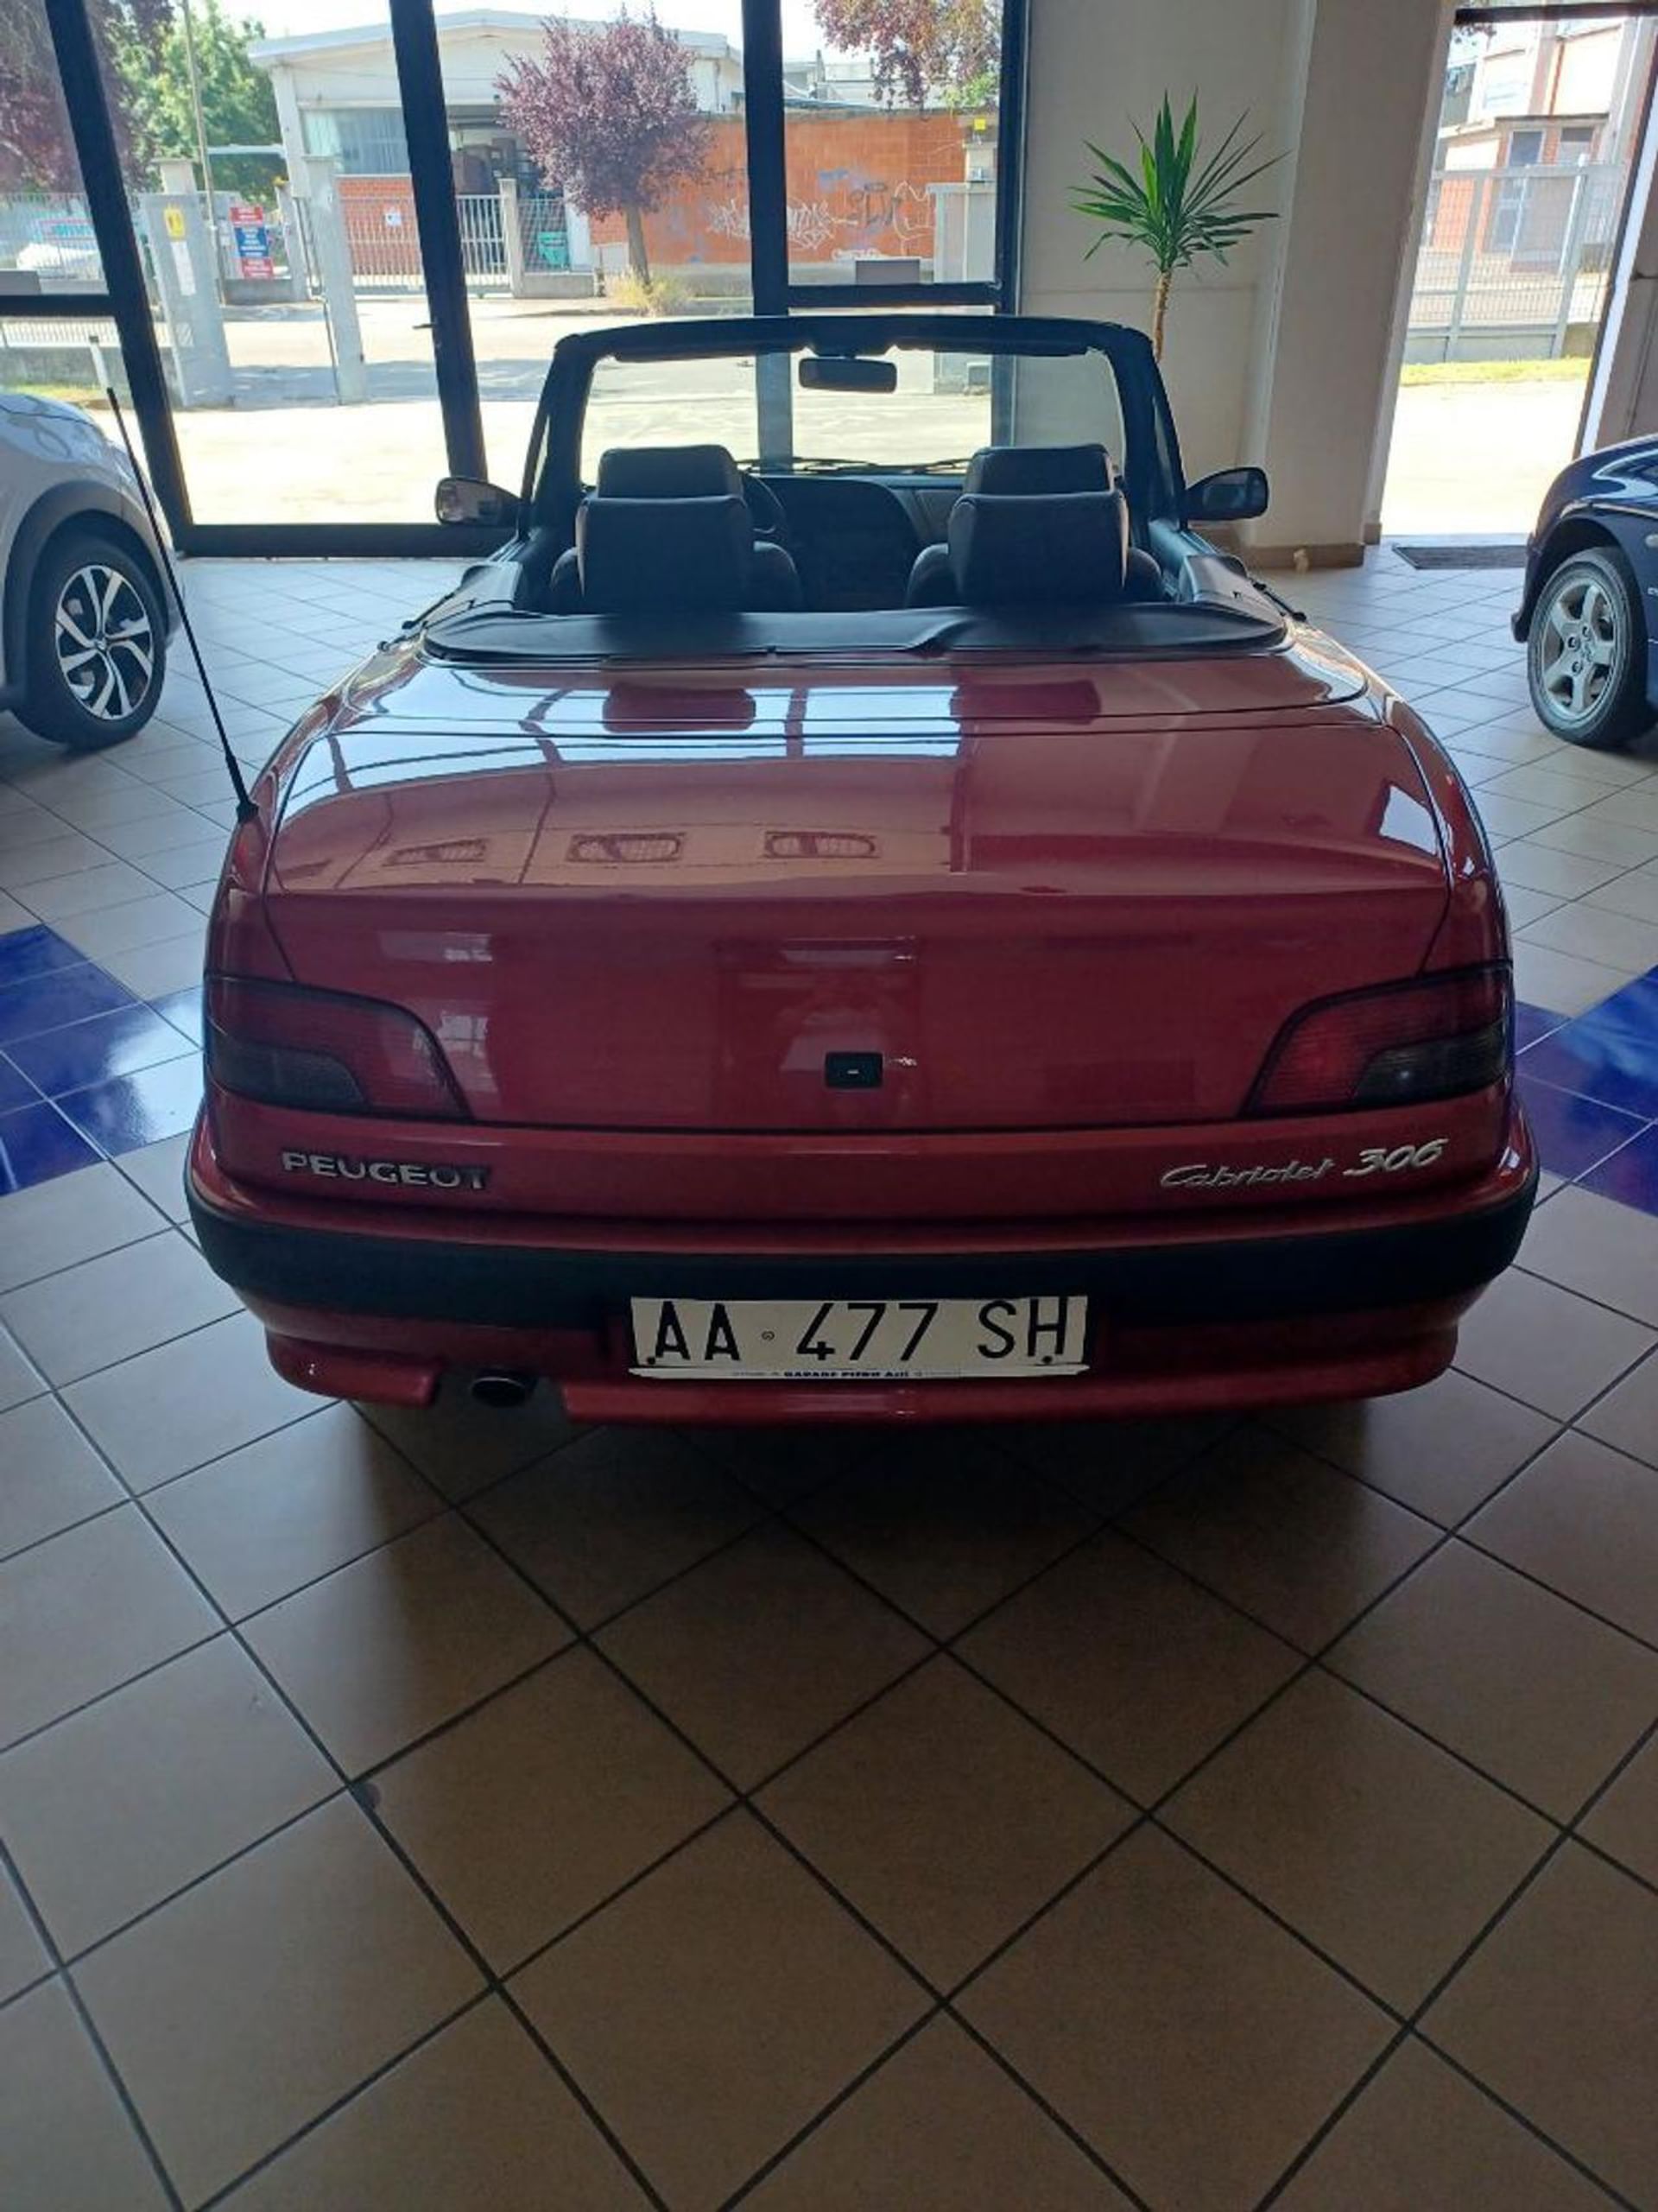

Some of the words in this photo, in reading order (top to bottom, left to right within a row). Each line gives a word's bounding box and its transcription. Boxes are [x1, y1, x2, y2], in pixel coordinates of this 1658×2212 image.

[282, 1151, 490, 1189] PEUGEOT
[1160, 1157, 1336, 1188] Cabriolet
[1343, 1137, 1450, 1176] 306
[655, 1300, 741, 1361] AA
[795, 1302, 940, 1361] 477
[977, 1296, 1068, 1359] SH
